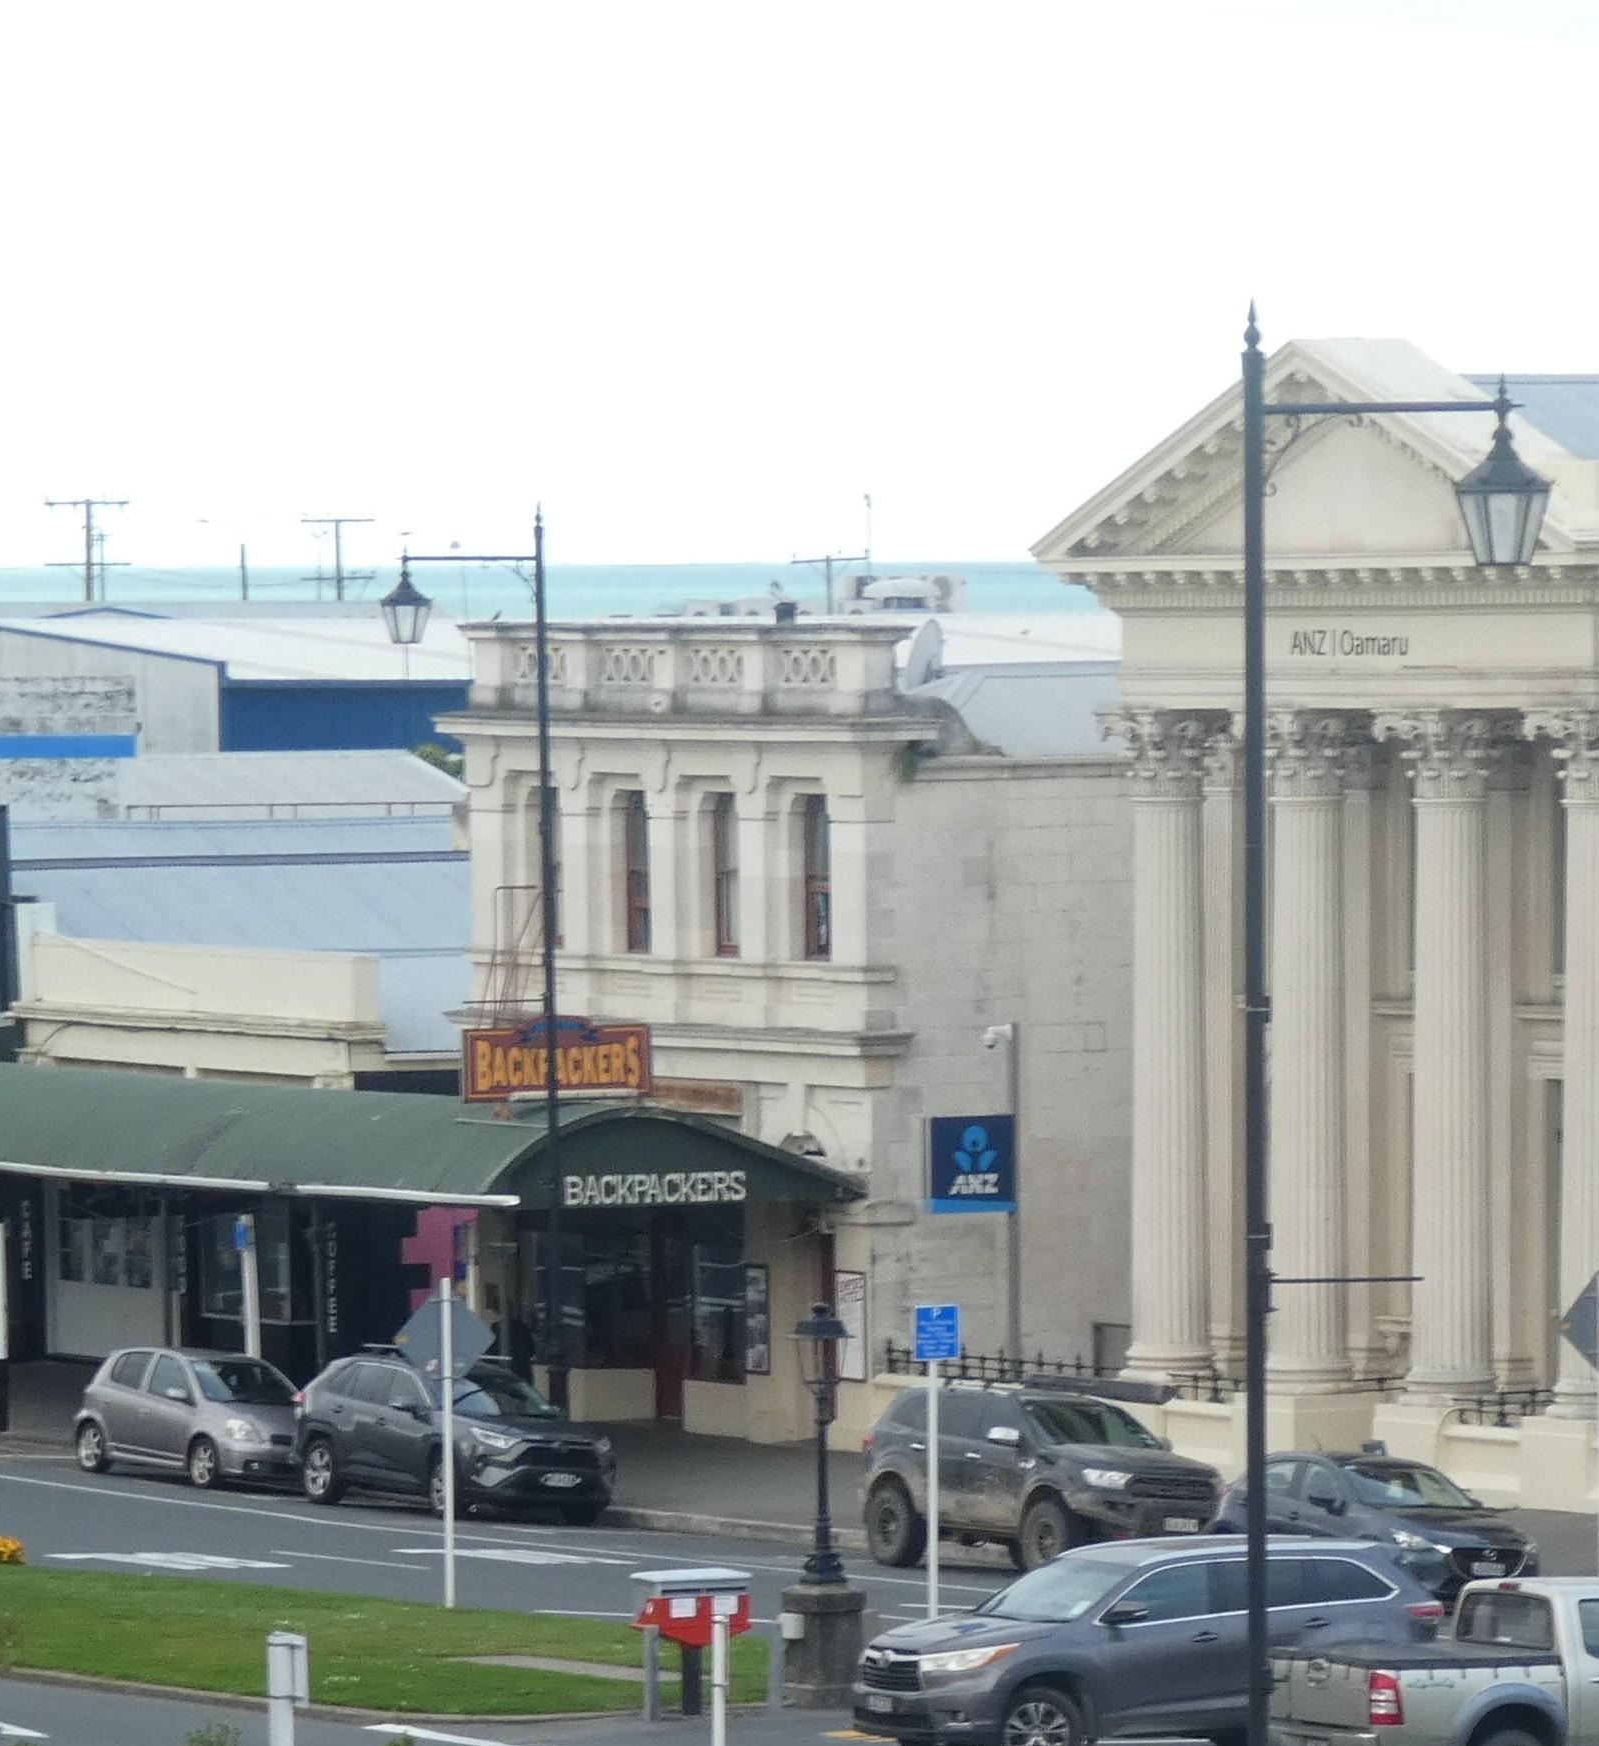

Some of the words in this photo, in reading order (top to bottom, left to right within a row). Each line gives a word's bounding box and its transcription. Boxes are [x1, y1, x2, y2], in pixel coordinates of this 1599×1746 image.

[1290, 629, 1327, 657] ANZ
[1340, 629, 1410, 657] Oamaru
[563, 1170, 748, 1206] BACKPACKERS
[949, 1172, 1000, 1196] ANZ
